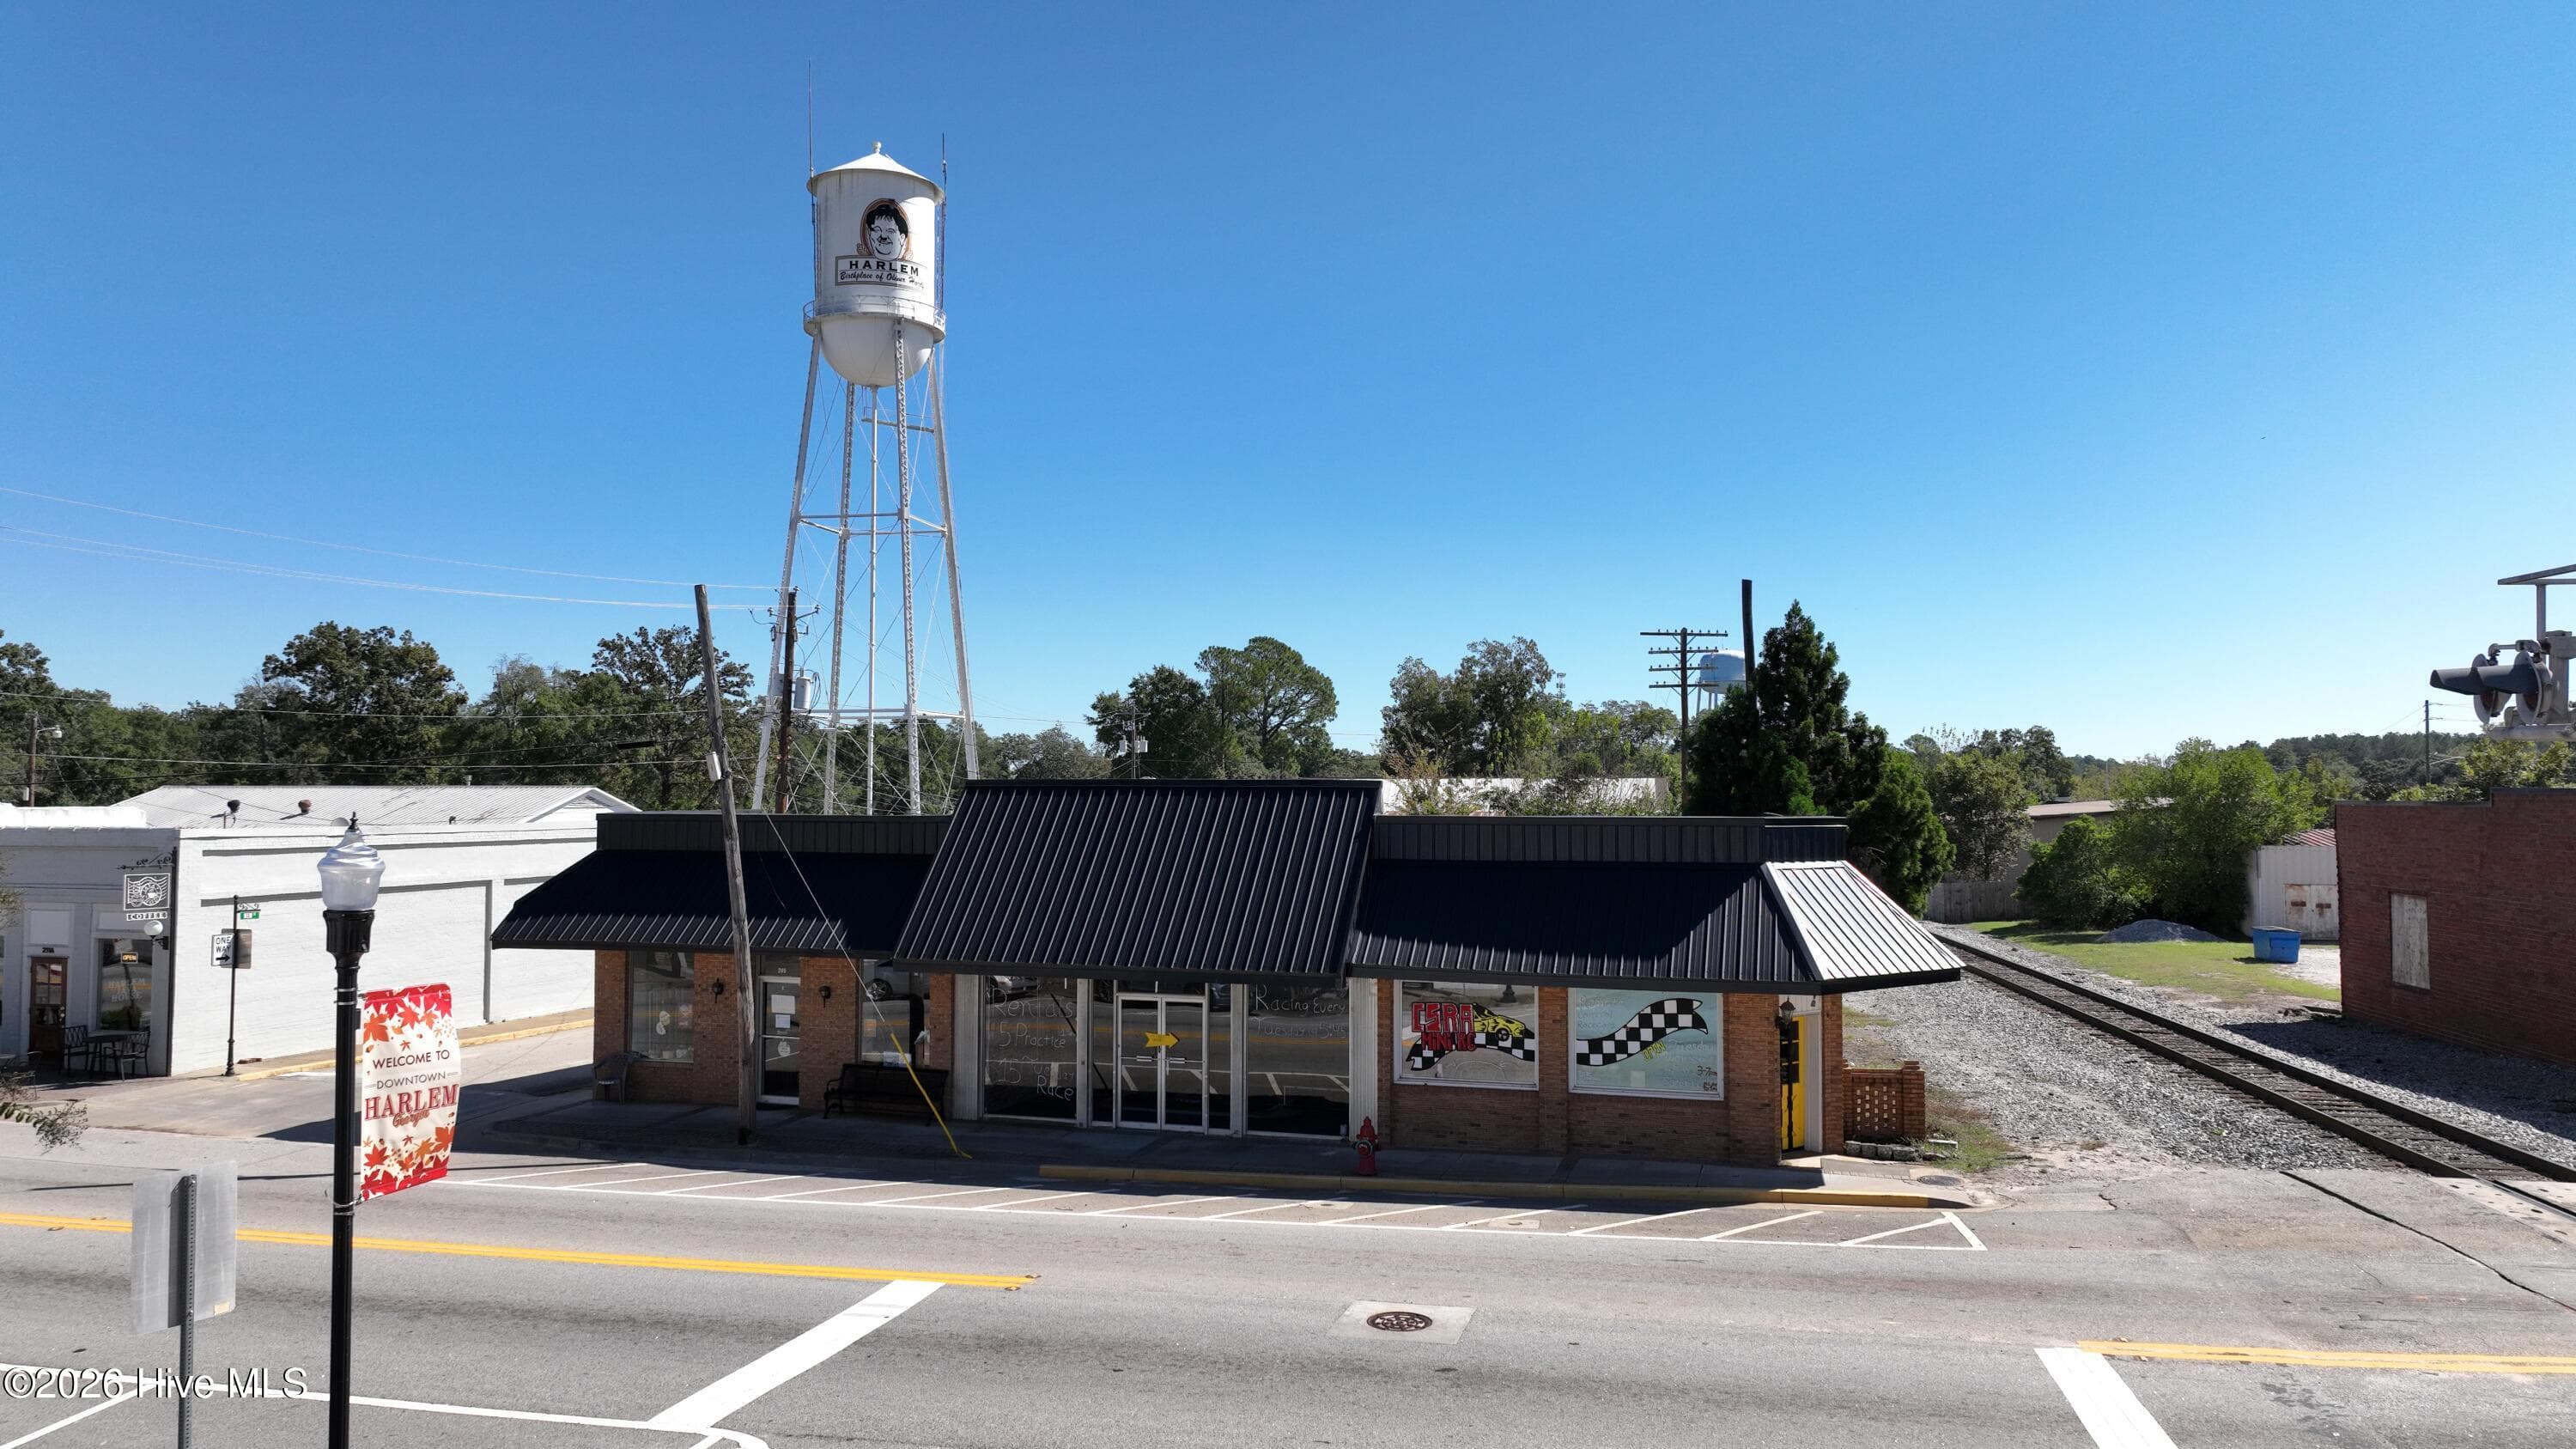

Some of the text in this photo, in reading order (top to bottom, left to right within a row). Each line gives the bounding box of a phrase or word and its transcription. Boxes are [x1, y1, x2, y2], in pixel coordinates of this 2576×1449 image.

[840, 271, 873, 282] Birthplace
[875, 271, 884, 282] of
[849, 260, 919, 277] HARLEM
[216, 936, 231, 945] ONE
[992, 988, 1074, 1018] Rentals
[1255, 983, 1346, 1017] Racing Every
[1412, 1002, 1475, 1032] CSRA
[1016, 1022, 1066, 1048] Practice
[1456, 1032, 1477, 1051] RC
[373, 1049, 450, 1069] WELCOME TO
[1642, 1040, 1666, 1060] OPEN
[376, 1071, 446, 1090] DOWNTOWN
[1036, 1075, 1074, 1101] Race
[365, 1083, 459, 1120] HARLEM
[392, 1108, 430, 1129] Georgia
